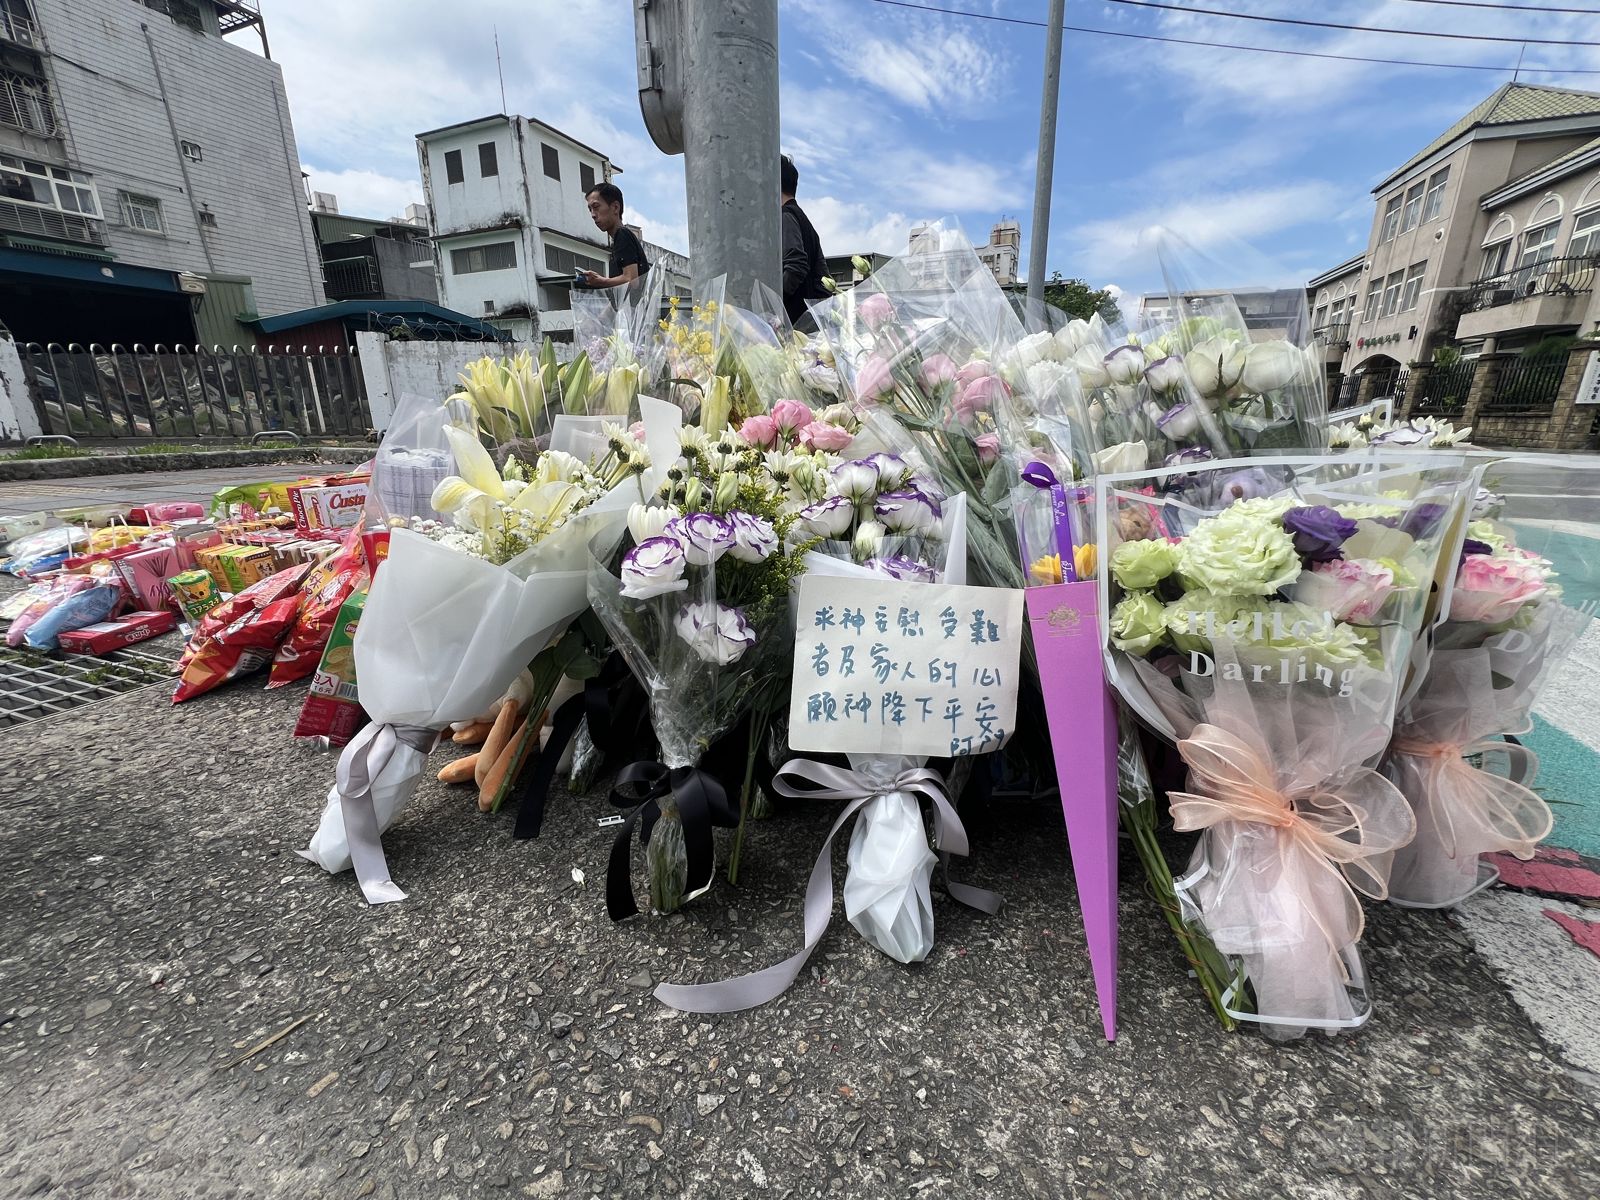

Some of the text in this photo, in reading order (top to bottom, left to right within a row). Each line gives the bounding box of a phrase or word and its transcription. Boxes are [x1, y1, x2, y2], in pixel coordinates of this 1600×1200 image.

[329, 493, 366, 509] Custa
[811, 642, 1001, 688] 者及家人的心
[1188, 649, 1353, 698] Darling
